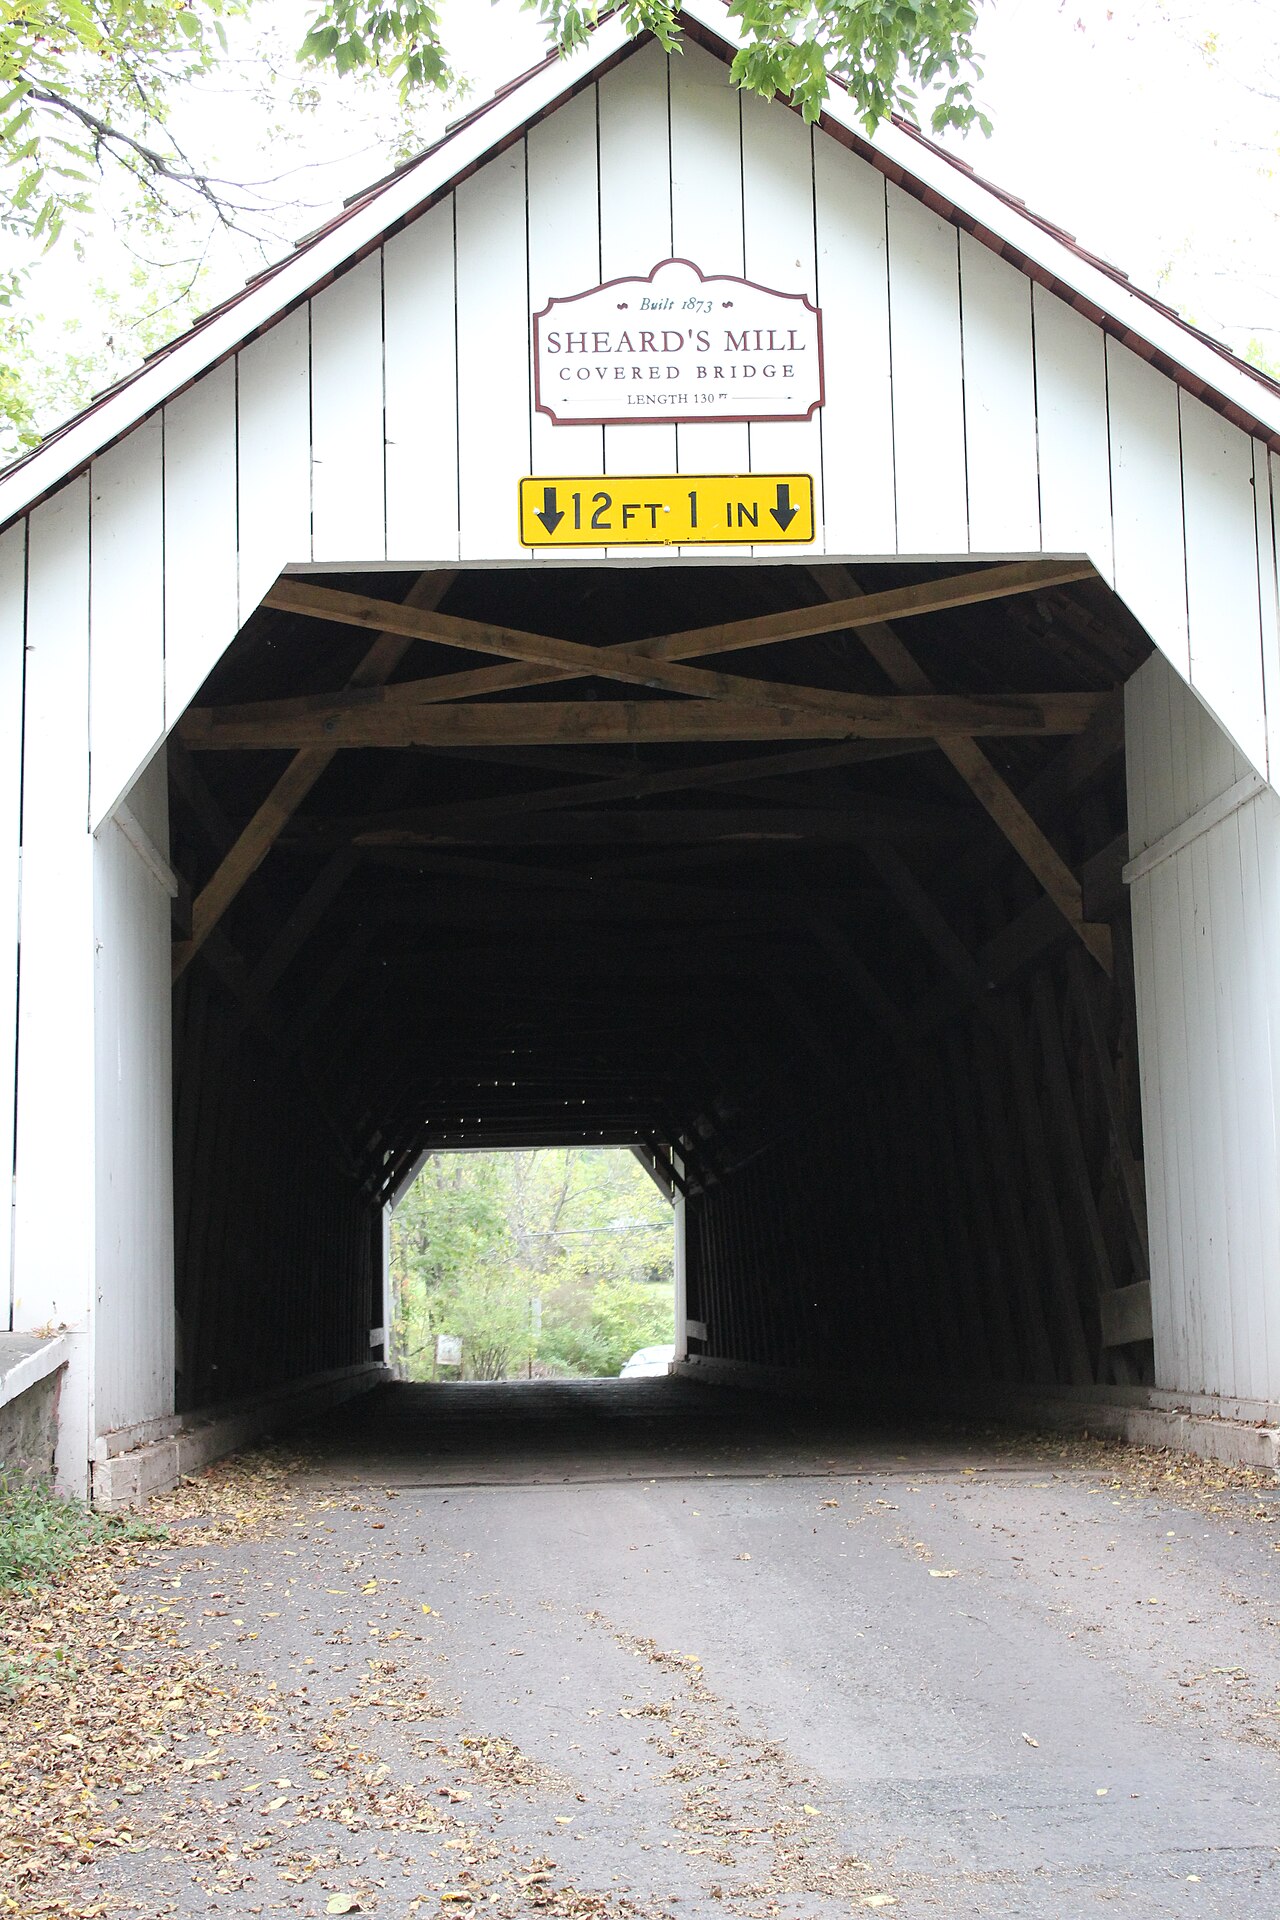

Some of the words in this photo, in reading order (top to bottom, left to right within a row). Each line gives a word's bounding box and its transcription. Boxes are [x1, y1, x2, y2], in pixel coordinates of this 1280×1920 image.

[640, 298, 674, 311] Built
[681, 298, 713, 313] 1873
[547, 329, 711, 353] SHEARD'S
[724, 329, 806, 352] MILL
[559, 366, 680, 381] COVERED
[697, 364, 796, 379] BRIDGE
[627, 393, 688, 405] LENGTH
[694, 393, 715, 404] 130
[571, 491, 613, 530] 12
[622, 503, 663, 529] FT
[688, 491, 698, 528] 1
[726, 502, 758, 527] IN
